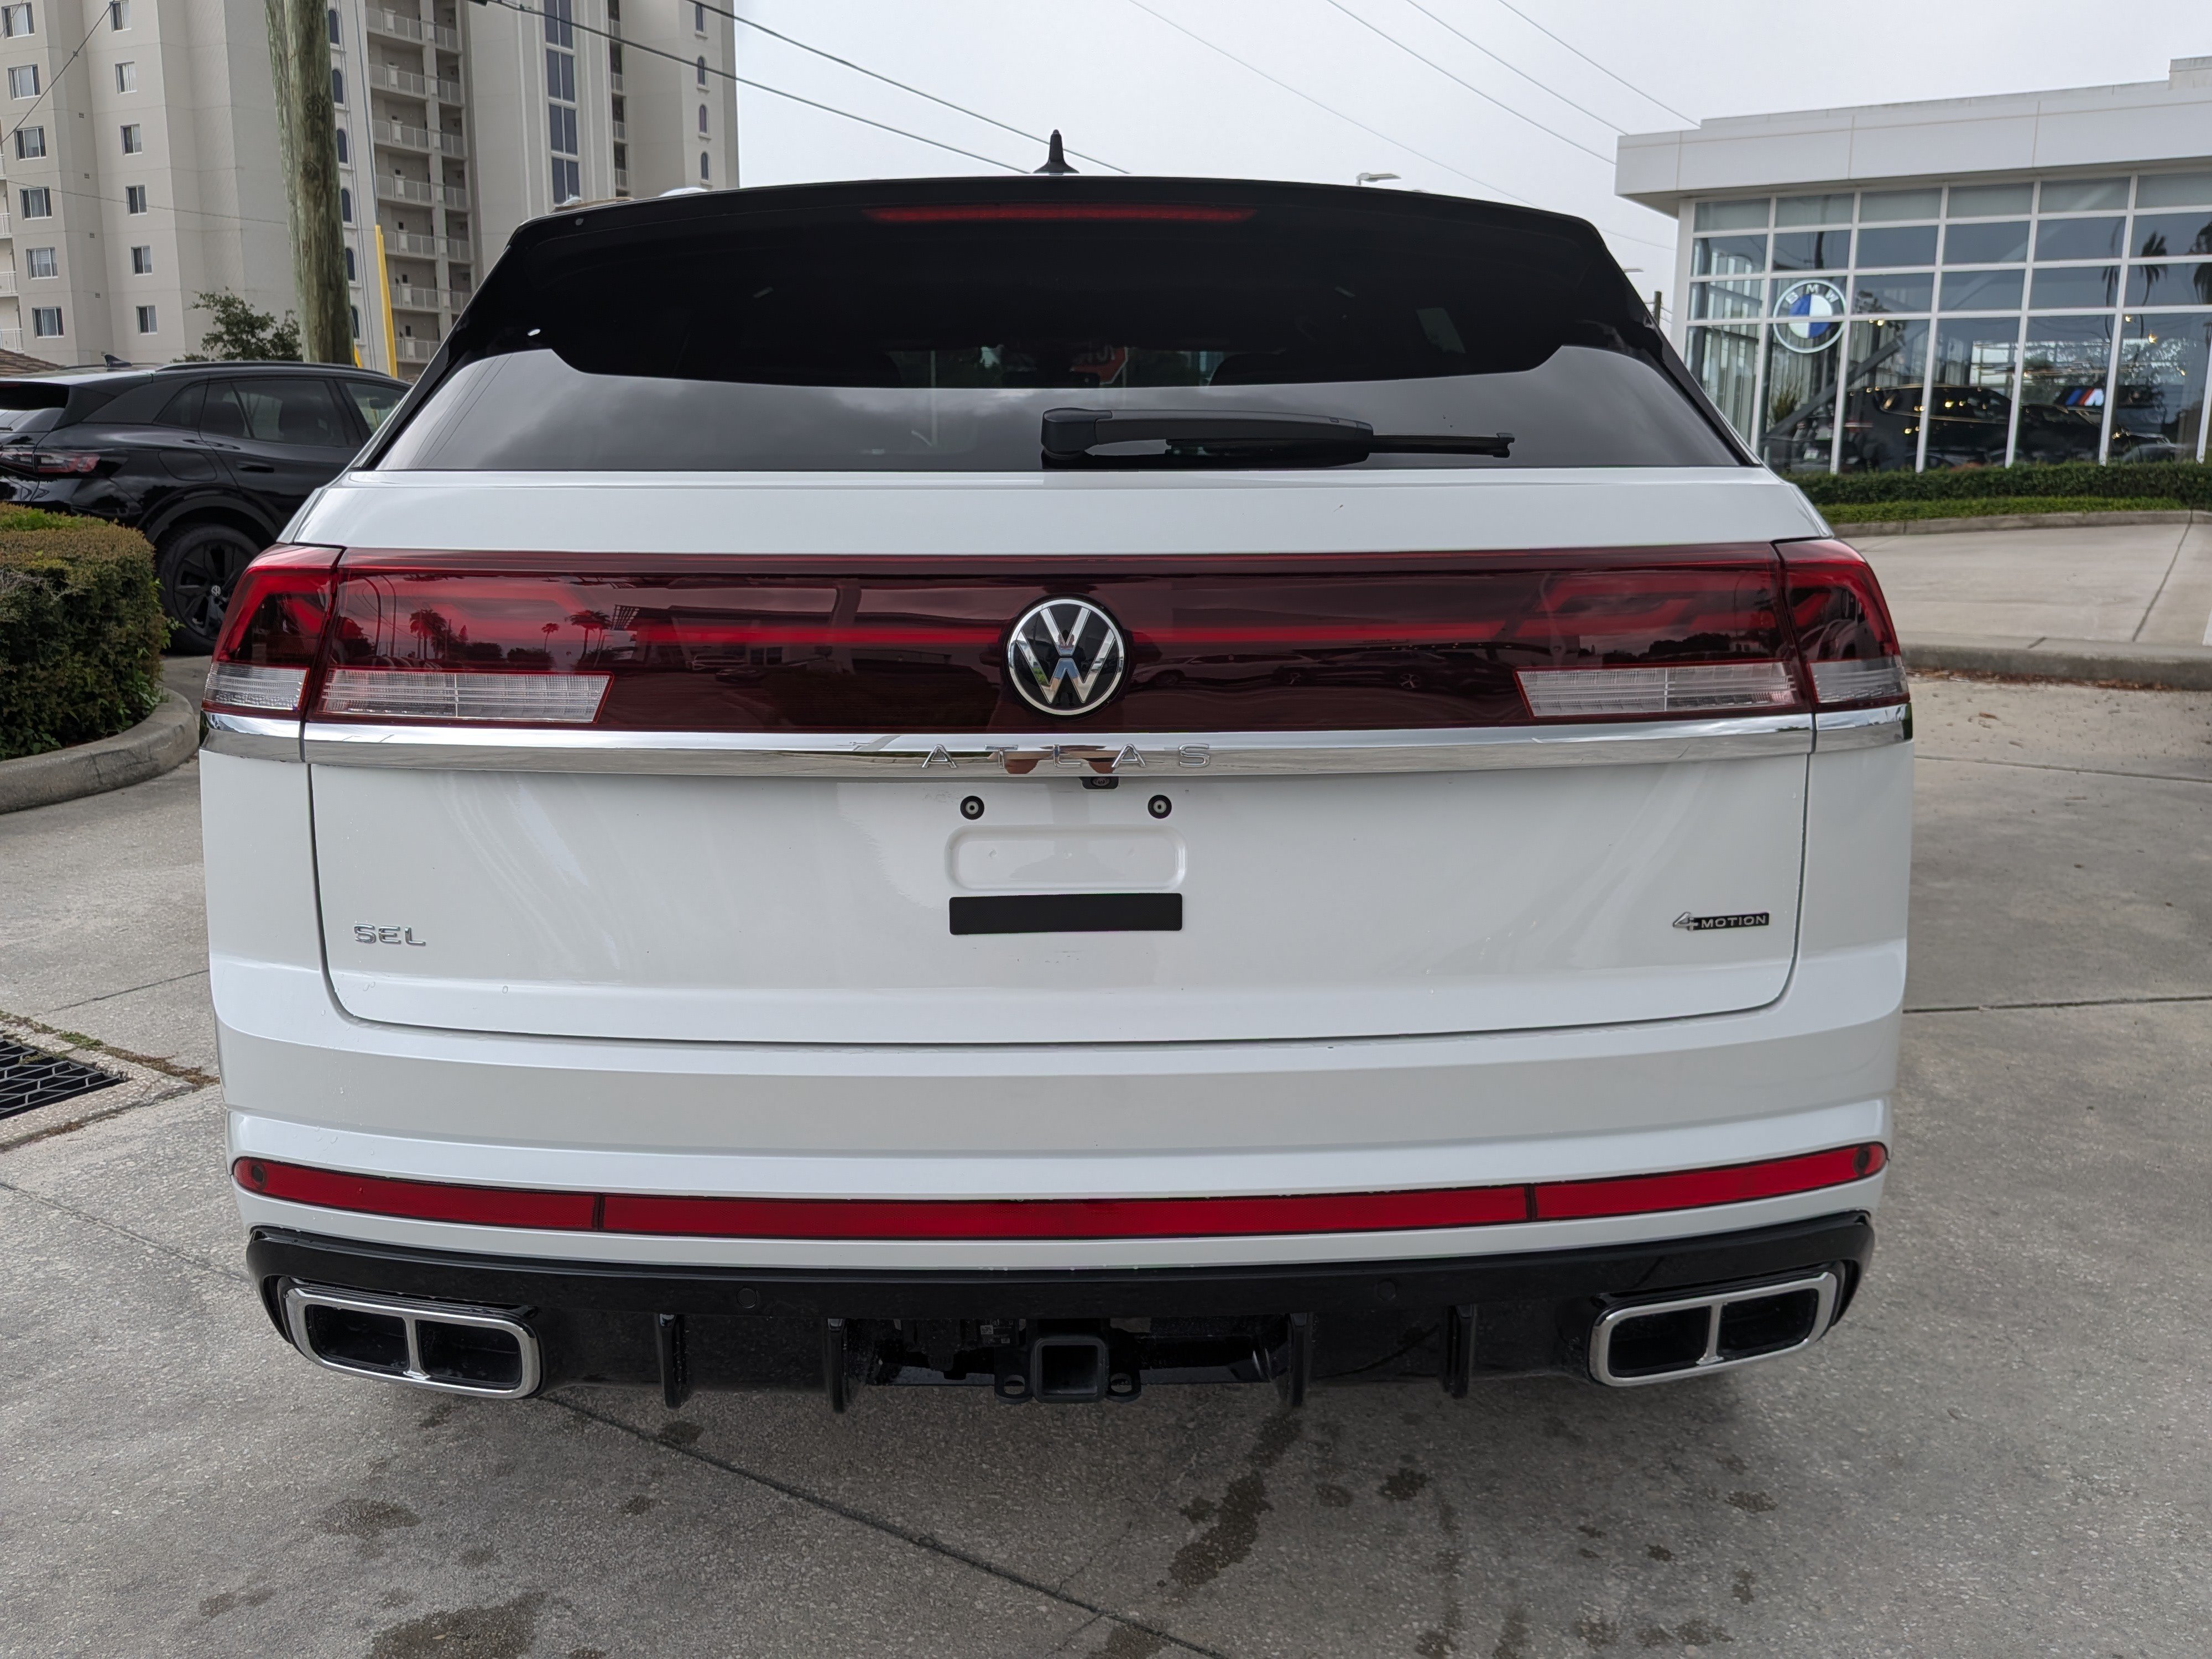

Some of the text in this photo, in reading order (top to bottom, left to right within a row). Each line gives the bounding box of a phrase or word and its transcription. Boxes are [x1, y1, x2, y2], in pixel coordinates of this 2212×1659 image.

[1785, 284, 1839, 305] BMW
[921, 743, 1211, 769] ATLAS
[353, 923, 426, 946] SEL
